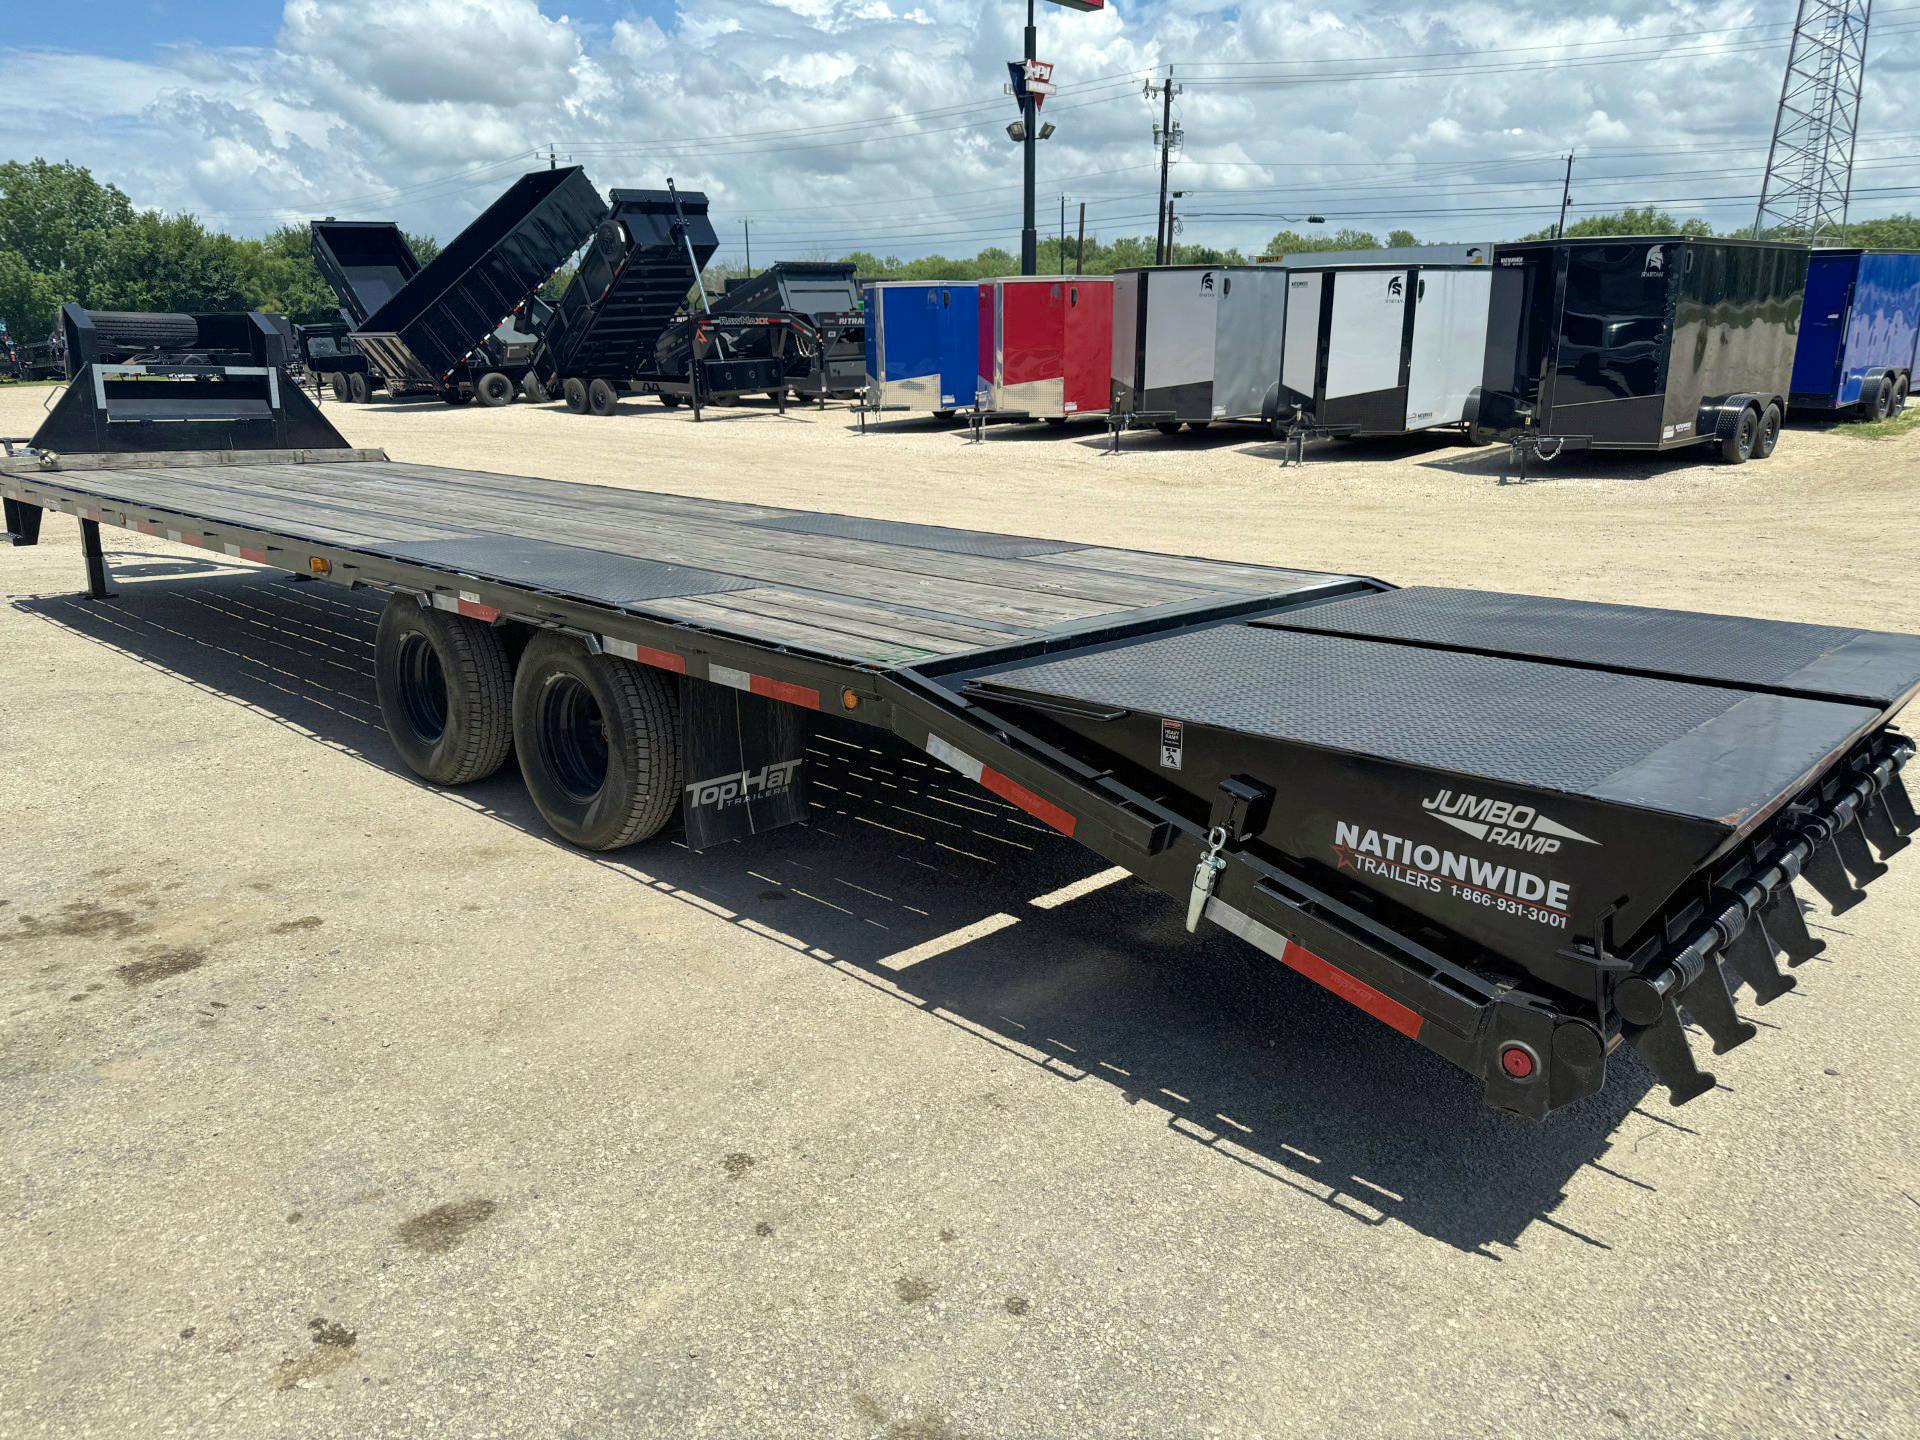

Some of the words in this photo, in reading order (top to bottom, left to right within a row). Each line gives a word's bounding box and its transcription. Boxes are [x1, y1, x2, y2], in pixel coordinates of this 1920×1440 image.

[1421, 789, 1537, 830] JUMBO
[1335, 820, 1571, 911] NATIONWIDE
[1487, 827, 1561, 855] RAMP
[1354, 853, 1442, 893] TRAILERS
[1451, 884, 1567, 929] 1-866-931-3001
